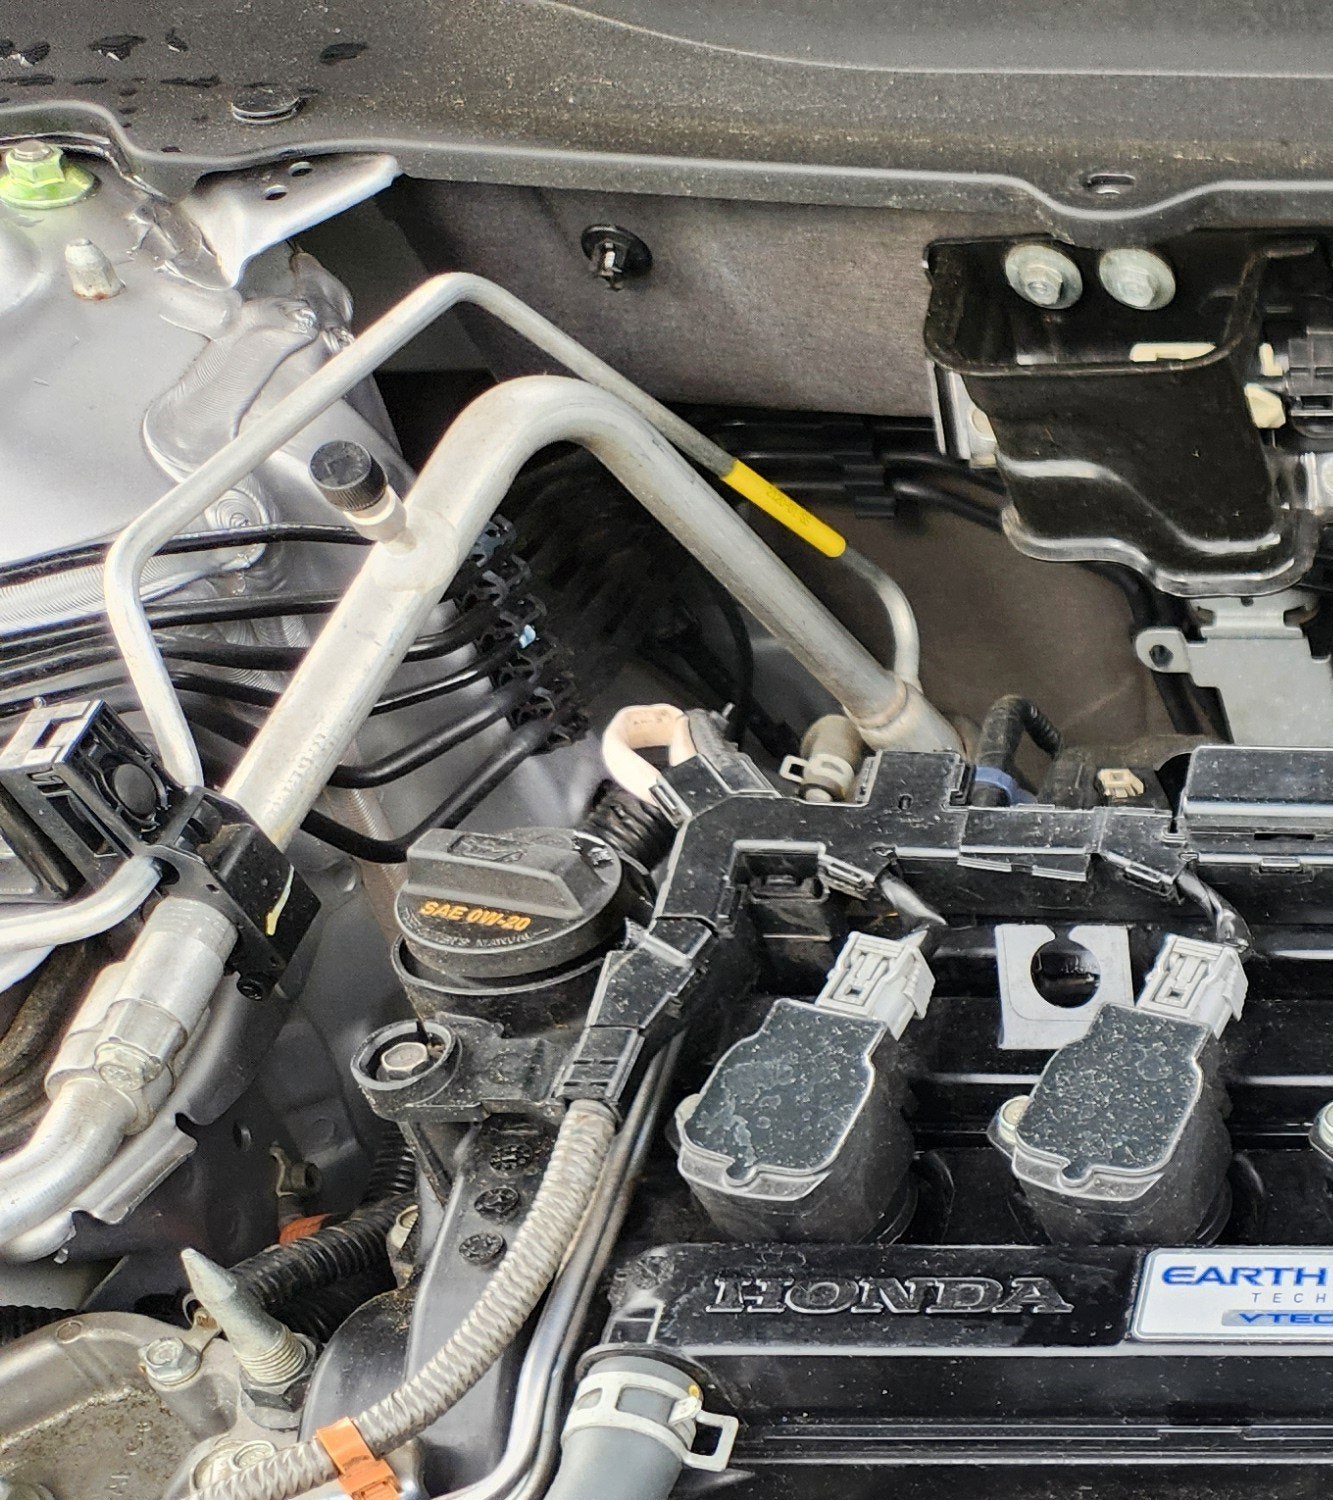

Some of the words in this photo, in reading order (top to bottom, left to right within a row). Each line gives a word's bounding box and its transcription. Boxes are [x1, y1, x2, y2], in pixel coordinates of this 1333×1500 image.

[419, 901, 468, 921] SAE
[466, 907, 532, 931] 0W-20
[1161, 1265, 1328, 1288] EARTH
[706, 1277, 1075, 1314] HONDA
